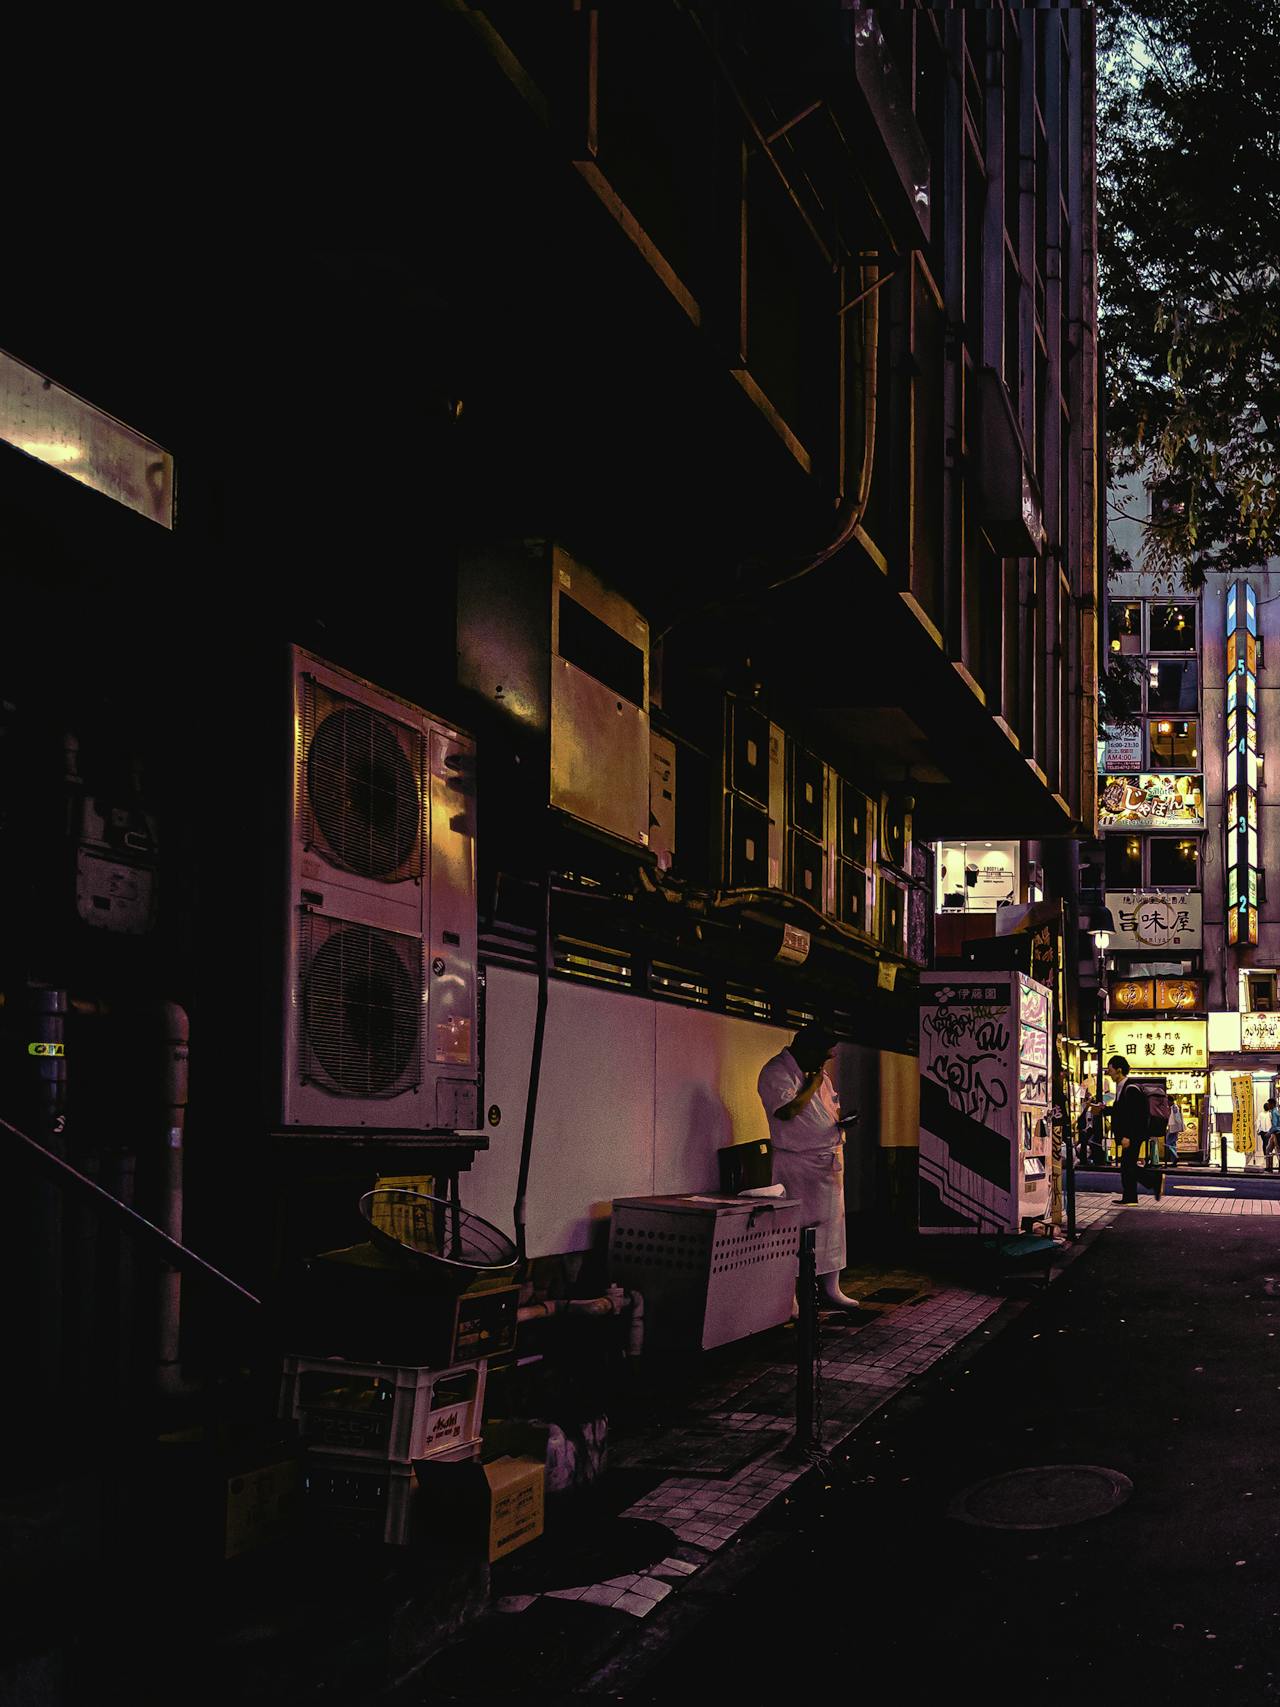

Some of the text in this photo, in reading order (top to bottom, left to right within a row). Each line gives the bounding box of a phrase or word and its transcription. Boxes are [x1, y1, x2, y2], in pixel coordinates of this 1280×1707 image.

[1237, 660, 1245, 675] 5
[1238, 738, 1246, 754] 4
[1238, 816, 1246, 833] 3
[1239, 895, 1247, 912] 2
[1118, 910, 1196, 933] 旨味屋
[958, 988, 997, 1000] 伊藤園
[1105, 1042, 1194, 1056] 三田製麺所
[433, 1410, 458, 1433] Asahi
